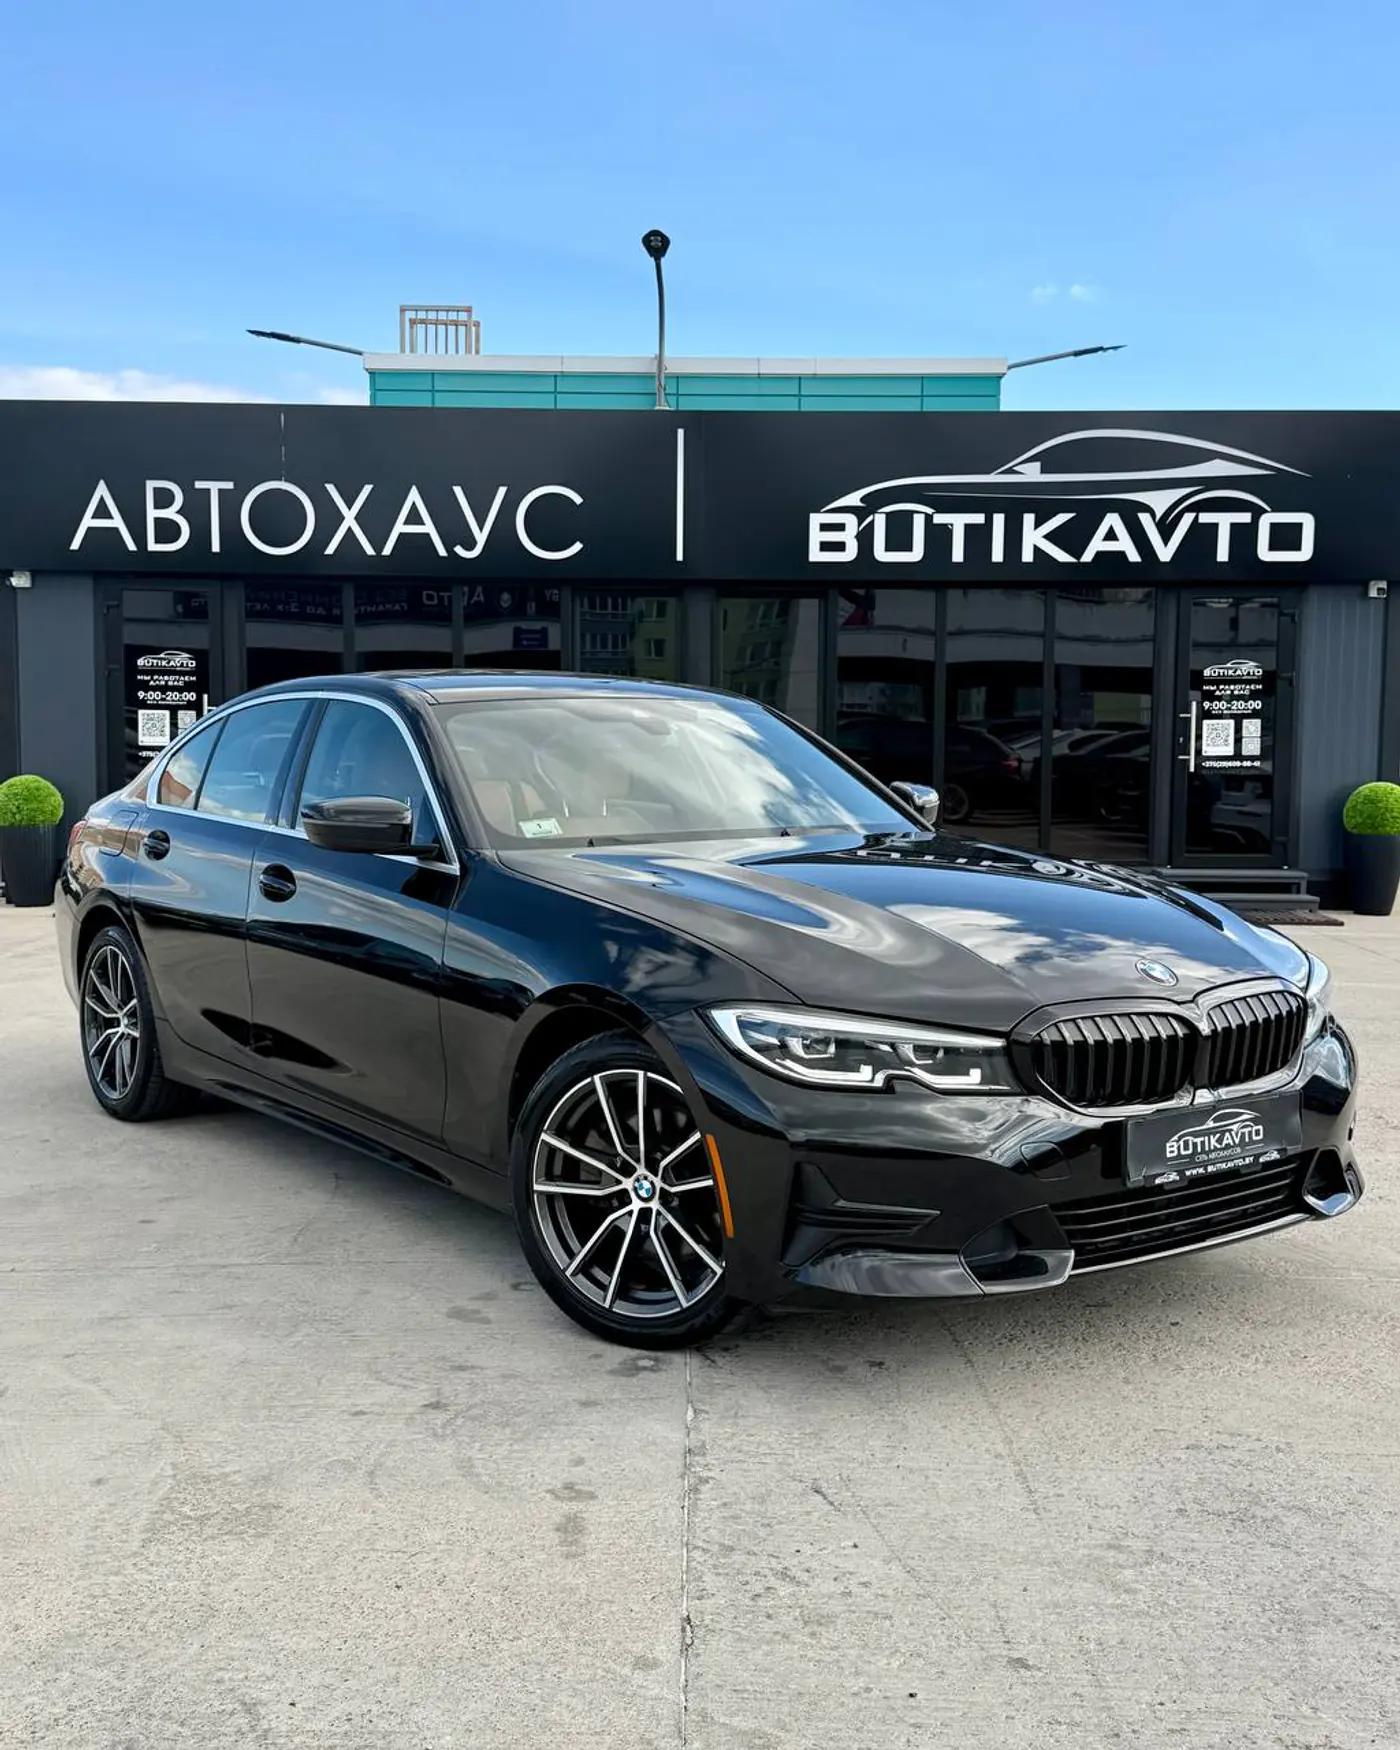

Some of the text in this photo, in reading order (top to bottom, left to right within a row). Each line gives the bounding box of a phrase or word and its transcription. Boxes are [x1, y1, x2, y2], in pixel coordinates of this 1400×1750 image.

[69, 478, 585, 560] АВТОХАУС
[808, 510, 1316, 563] BUTIKAVTO
[137, 690, 196, 701] 9:00-20:00
[1203, 700, 1262, 711] 9:00-20:00
[1166, 1125, 1264, 1158] BUTIKAVTO
